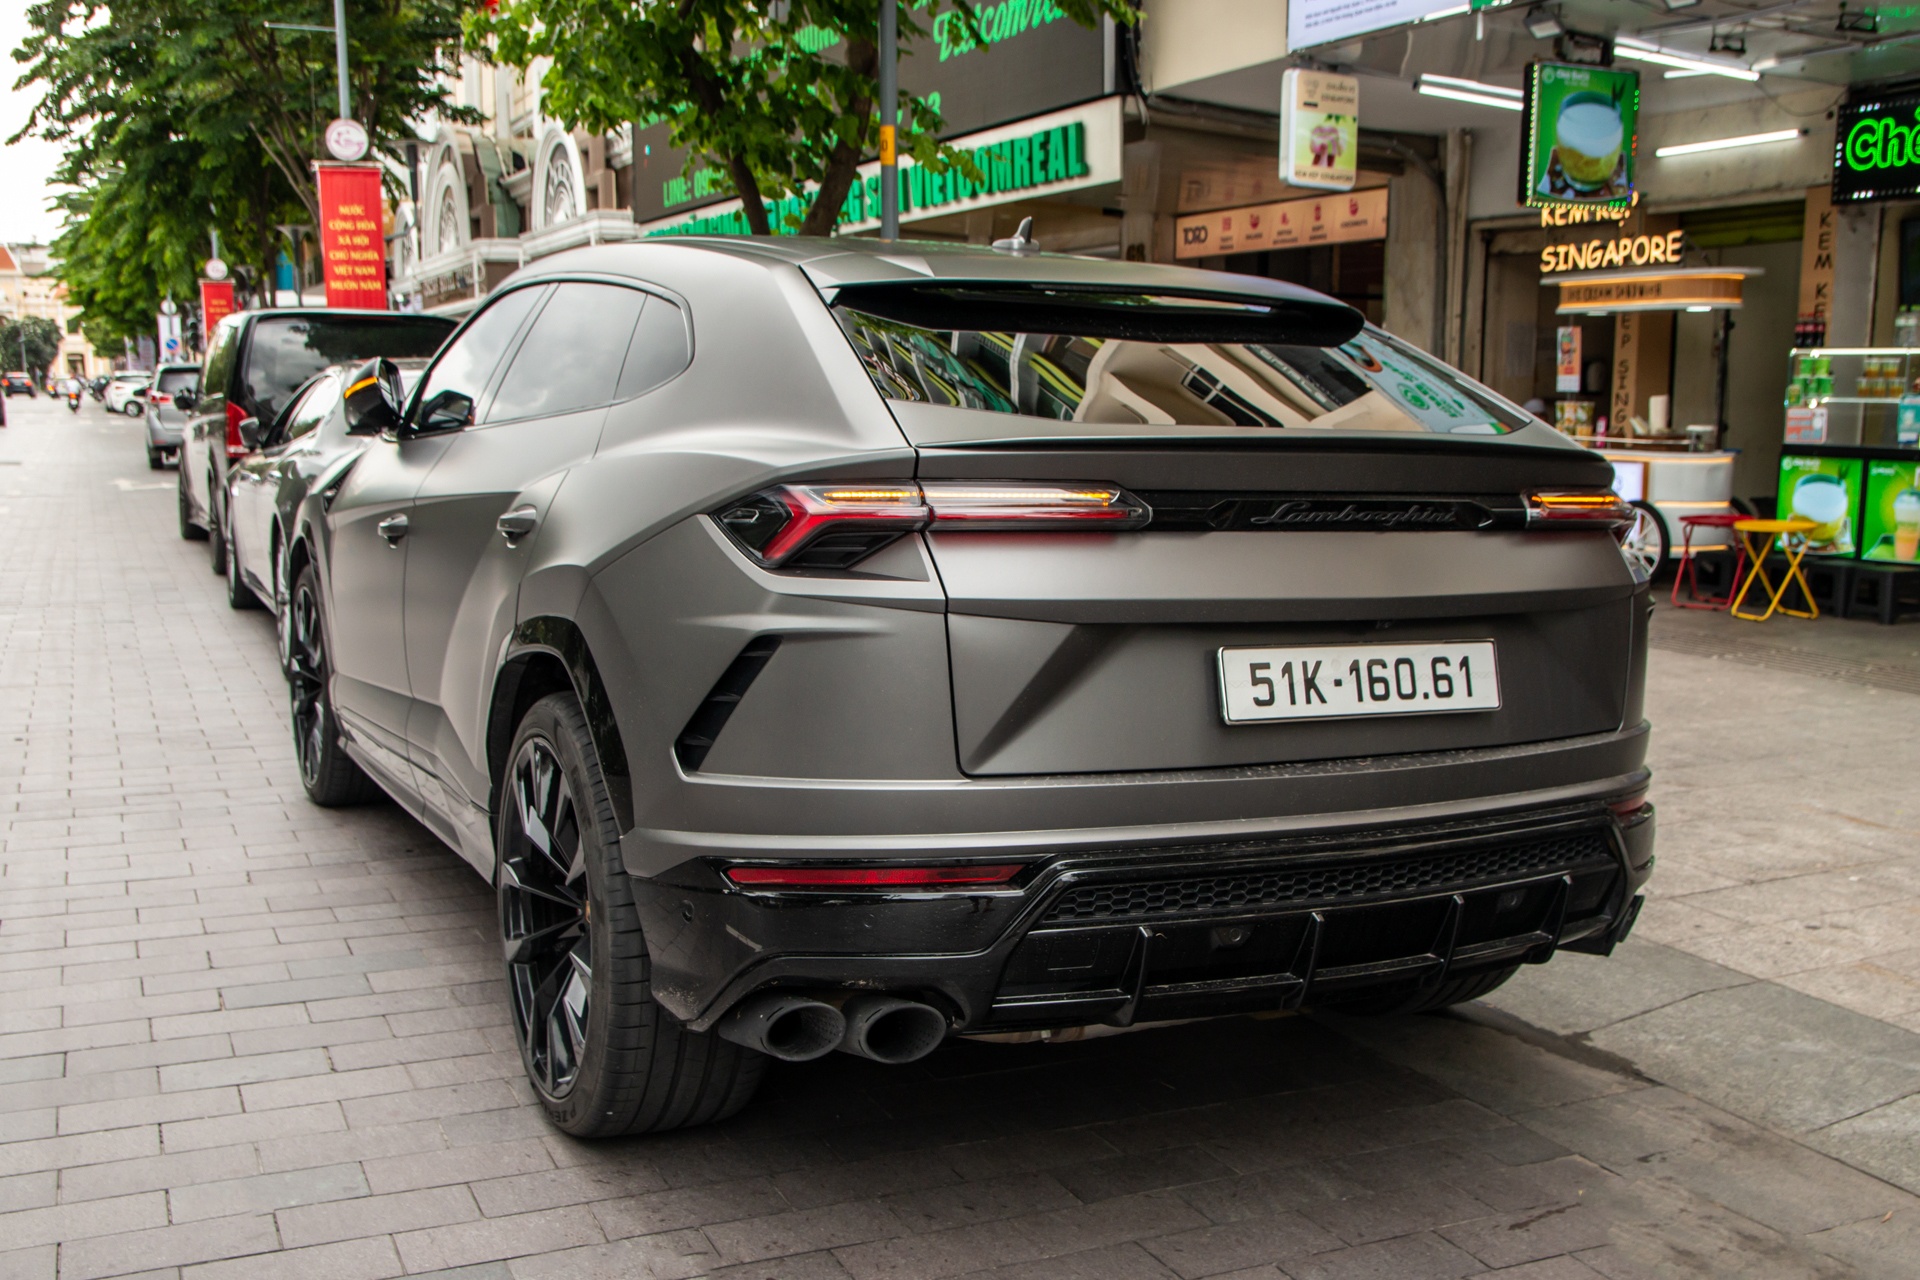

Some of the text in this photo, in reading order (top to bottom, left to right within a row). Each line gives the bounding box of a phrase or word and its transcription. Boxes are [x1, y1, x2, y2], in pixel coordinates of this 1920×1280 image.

[1540, 229, 1684, 273] SINGAPORE
[353, 265, 377, 276] NAM
[1250, 501, 1456, 526] Lamborghini
[1250, 655, 1473, 707] 51K-160.61
